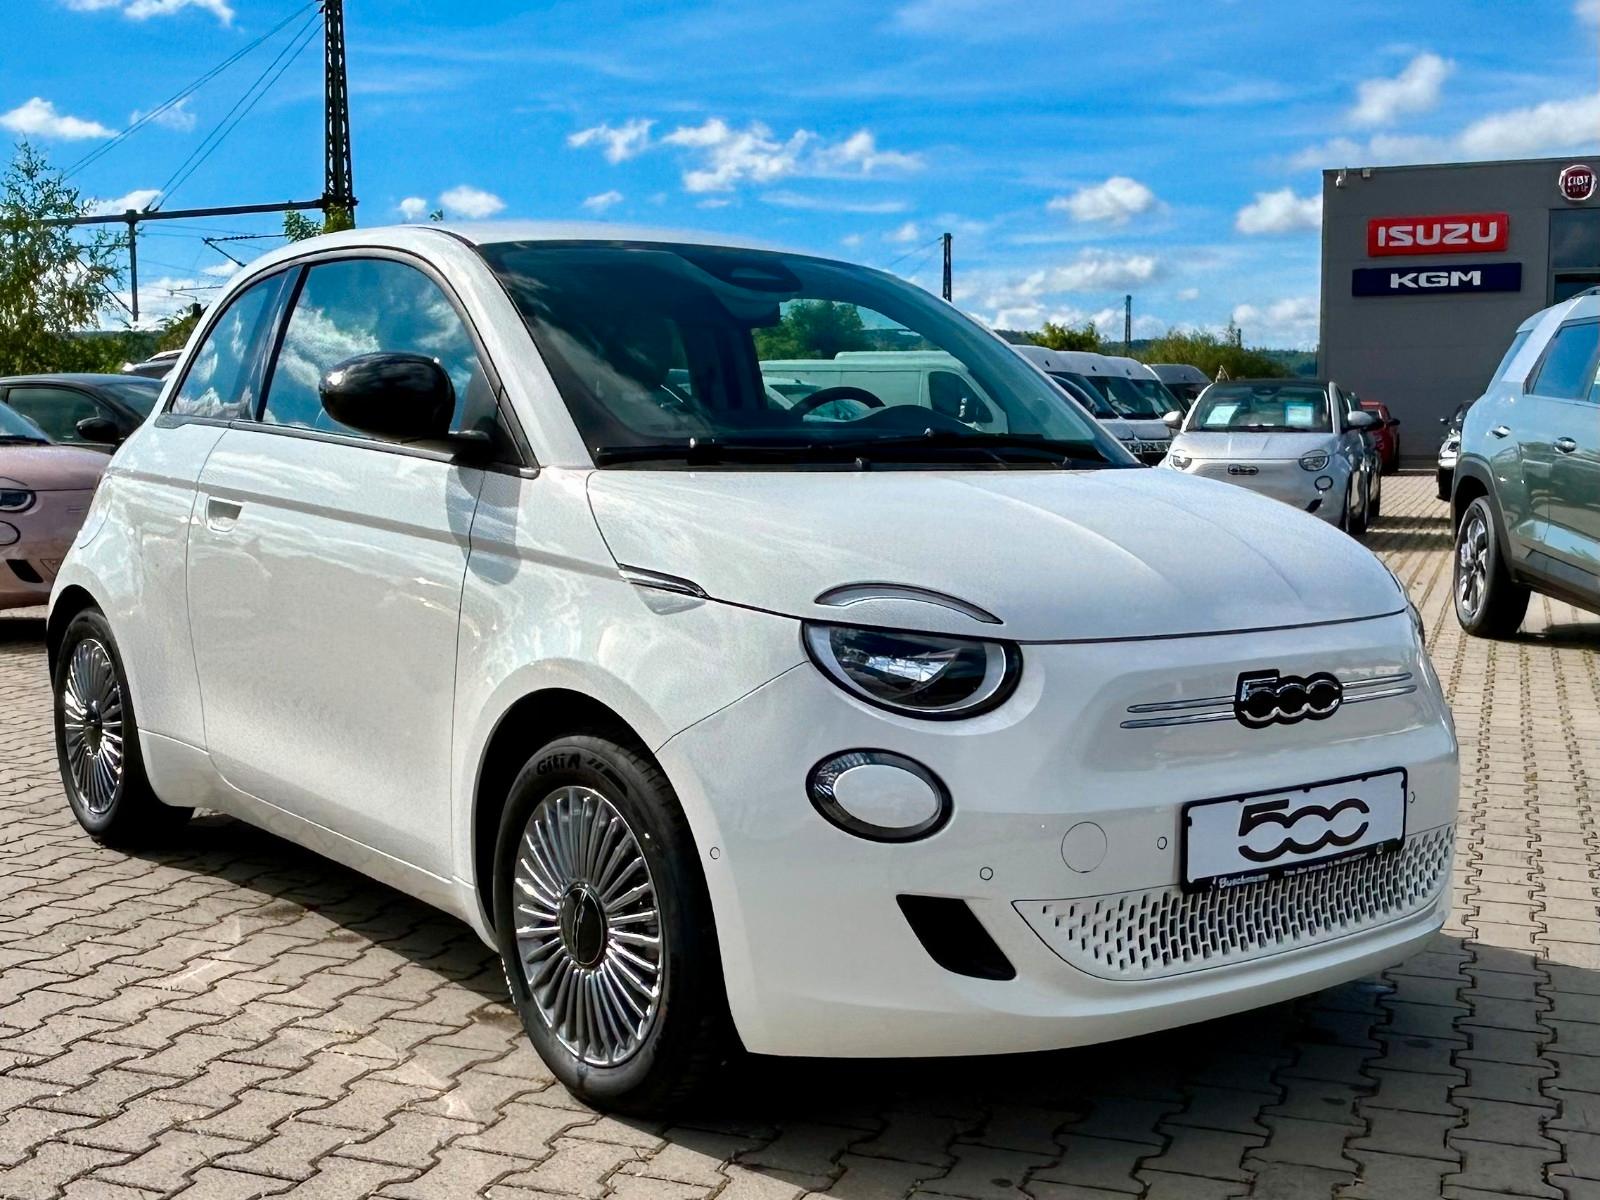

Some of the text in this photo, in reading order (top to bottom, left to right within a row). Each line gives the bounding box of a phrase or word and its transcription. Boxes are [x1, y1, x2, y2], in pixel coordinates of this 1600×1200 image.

[1377, 221, 1498, 247] ISUZU
[1390, 270, 1482, 289] KGM
[1236, 672, 1342, 725] 500
[1238, 798, 1370, 863] 500
